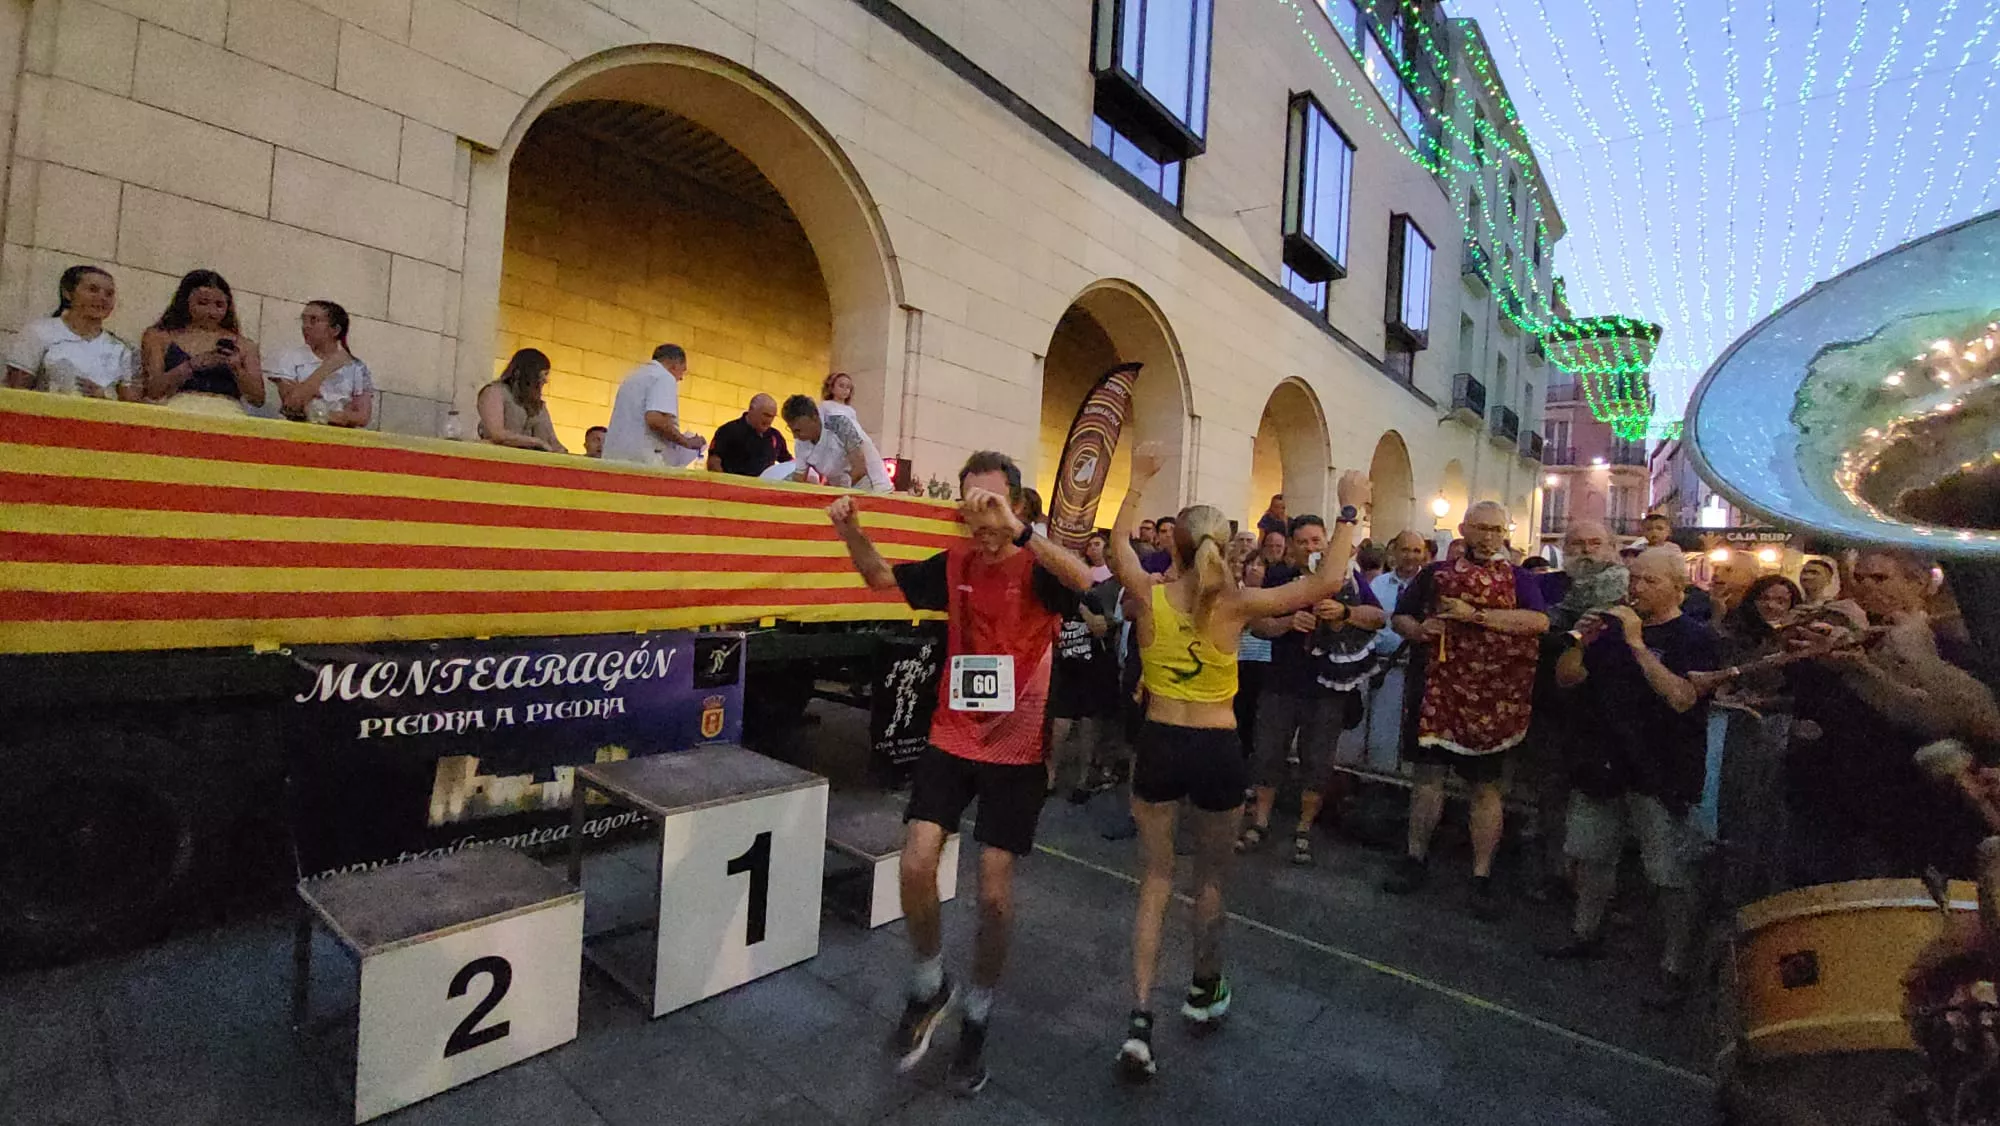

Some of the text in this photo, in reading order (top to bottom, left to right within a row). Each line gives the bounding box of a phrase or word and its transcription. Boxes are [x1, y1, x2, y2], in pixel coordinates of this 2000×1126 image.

[1726, 532, 1757, 542] CAJA
[294, 641, 677, 704] MONTEARAGÓN
[973, 674, 996, 695] 60
[358, 695, 627, 739] PIEDRA A PIEDRA
[727, 830, 772, 946] 1
[443, 955, 512, 1059] 2
